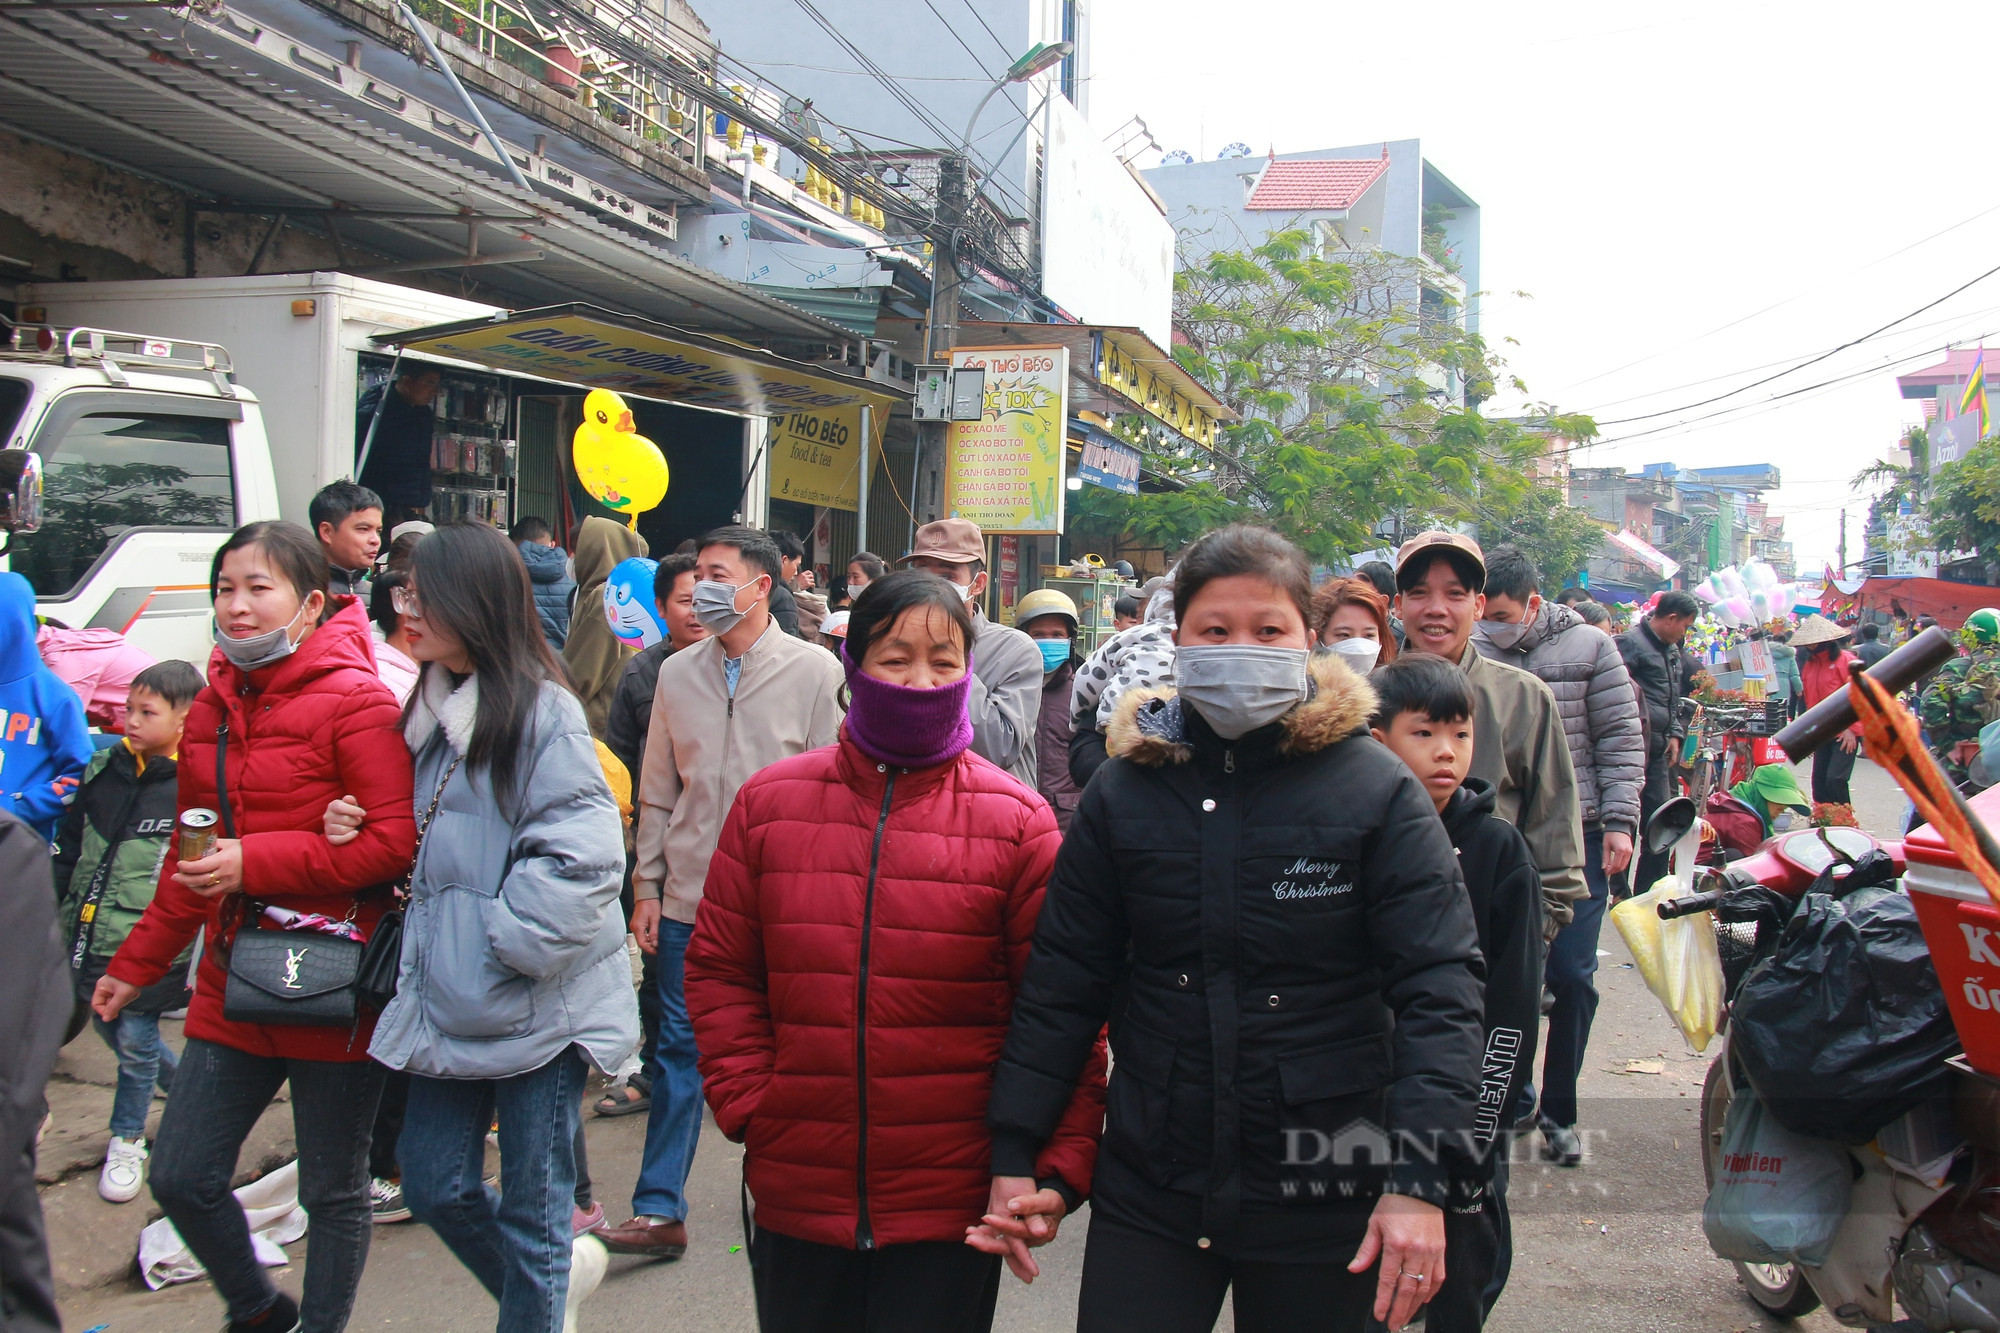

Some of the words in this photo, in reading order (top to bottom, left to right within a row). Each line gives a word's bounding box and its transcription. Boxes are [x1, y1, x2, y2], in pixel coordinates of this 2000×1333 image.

[507, 327, 612, 352] DÁN
[1006, 391, 1037, 409] 10K
[820, 417, 849, 446] BÉO
[993, 424, 1007, 433] ME
[790, 441, 810, 462] food
[810, 446, 819, 464] &
[819, 449, 833, 467] tea
[1017, 453, 1032, 462] ME
[1284, 856, 1341, 879] Merry
[1271, 880, 1353, 900] Christmas
